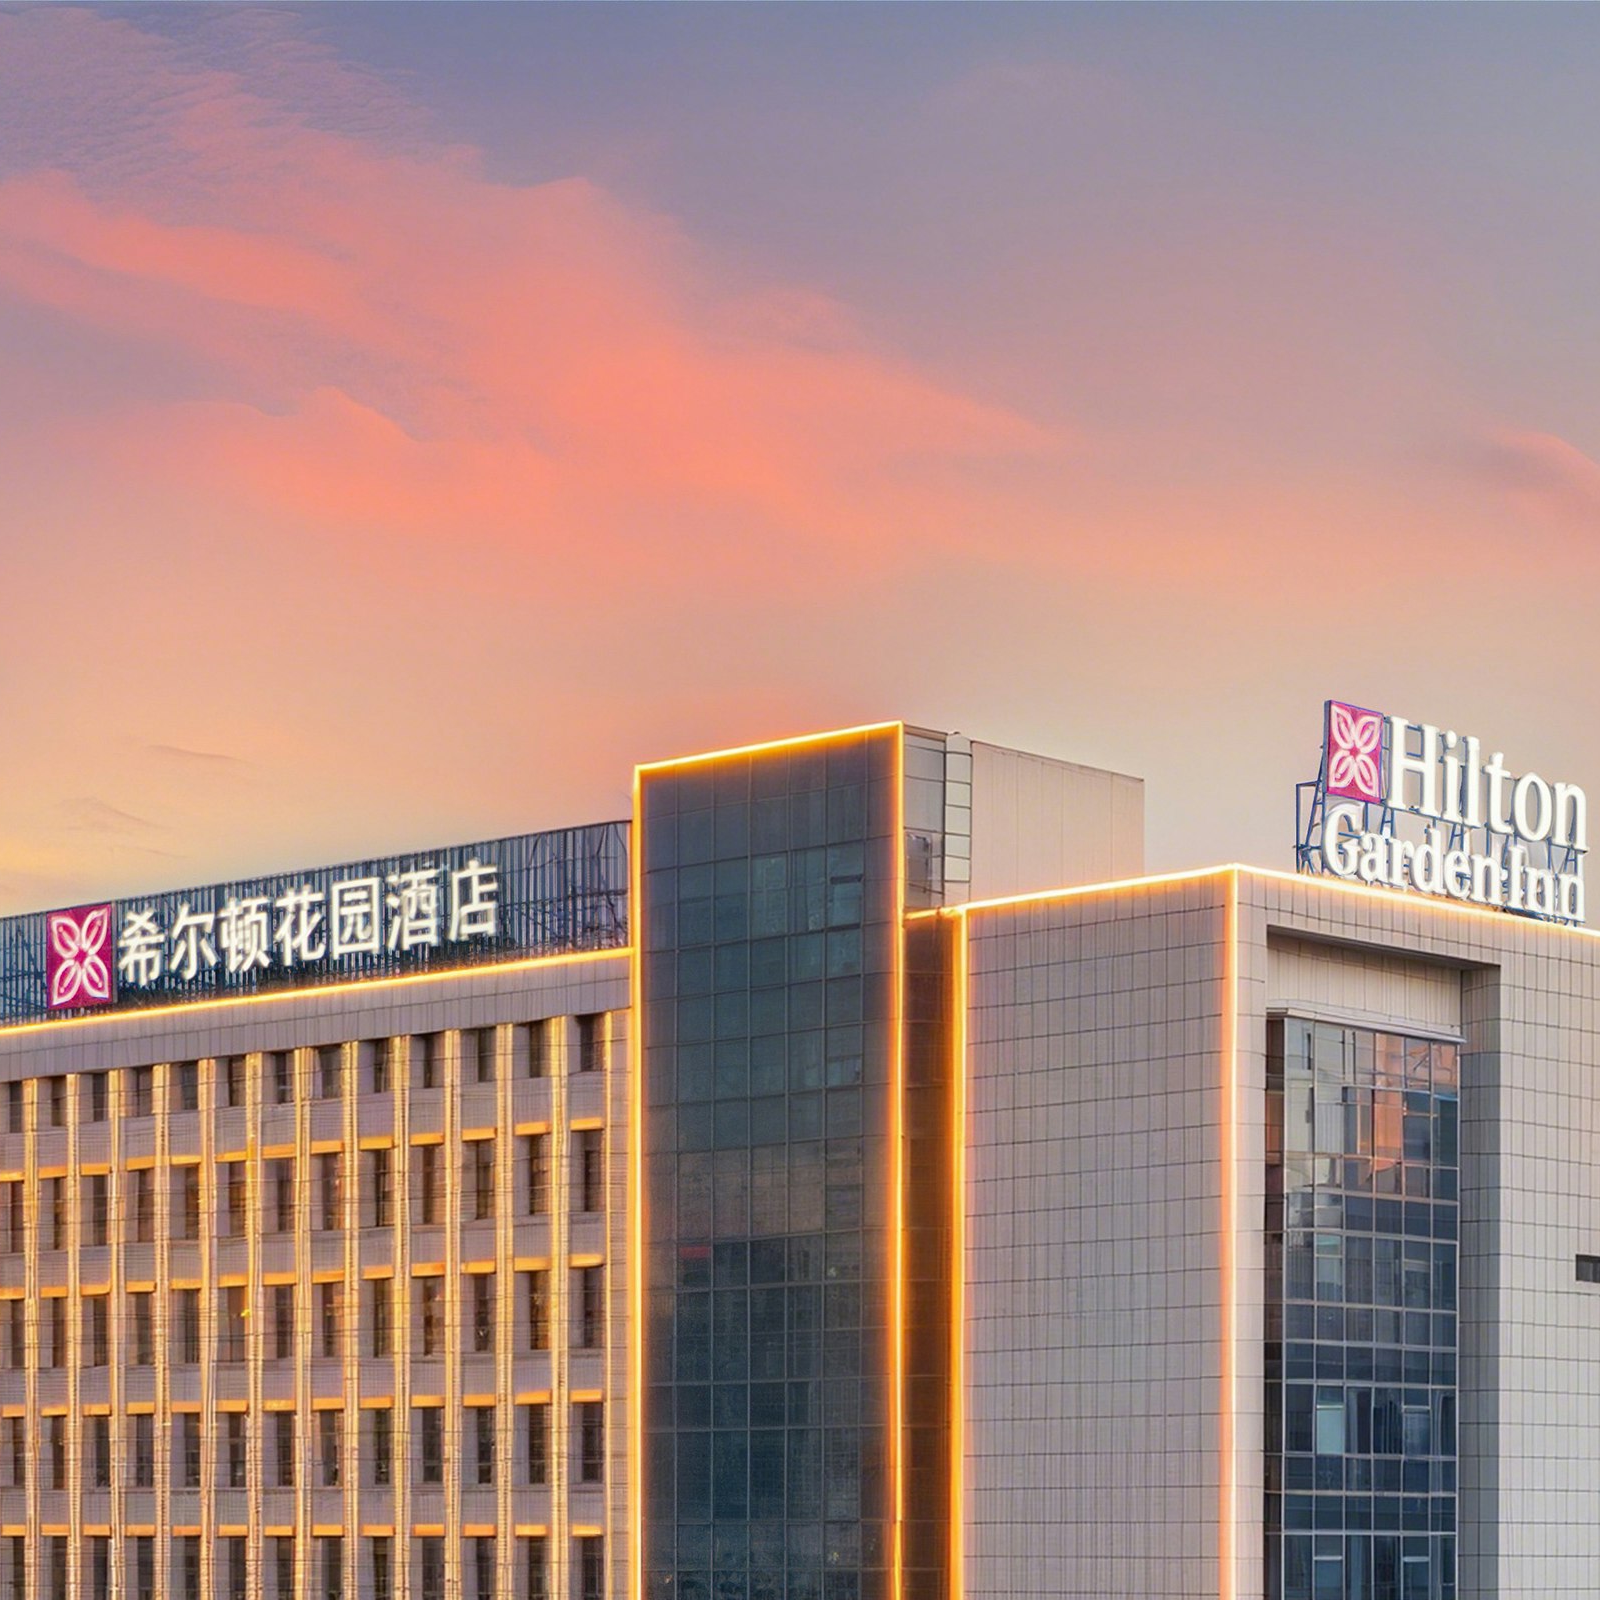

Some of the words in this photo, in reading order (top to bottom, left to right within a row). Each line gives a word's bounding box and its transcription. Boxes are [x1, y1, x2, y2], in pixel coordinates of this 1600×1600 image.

[1388, 714, 1590, 852] Hilton
[119, 859, 499, 985] 希尔顿花园酒店
[1323, 800, 1502, 906] Garden
[1507, 844, 1586, 923] Inn
